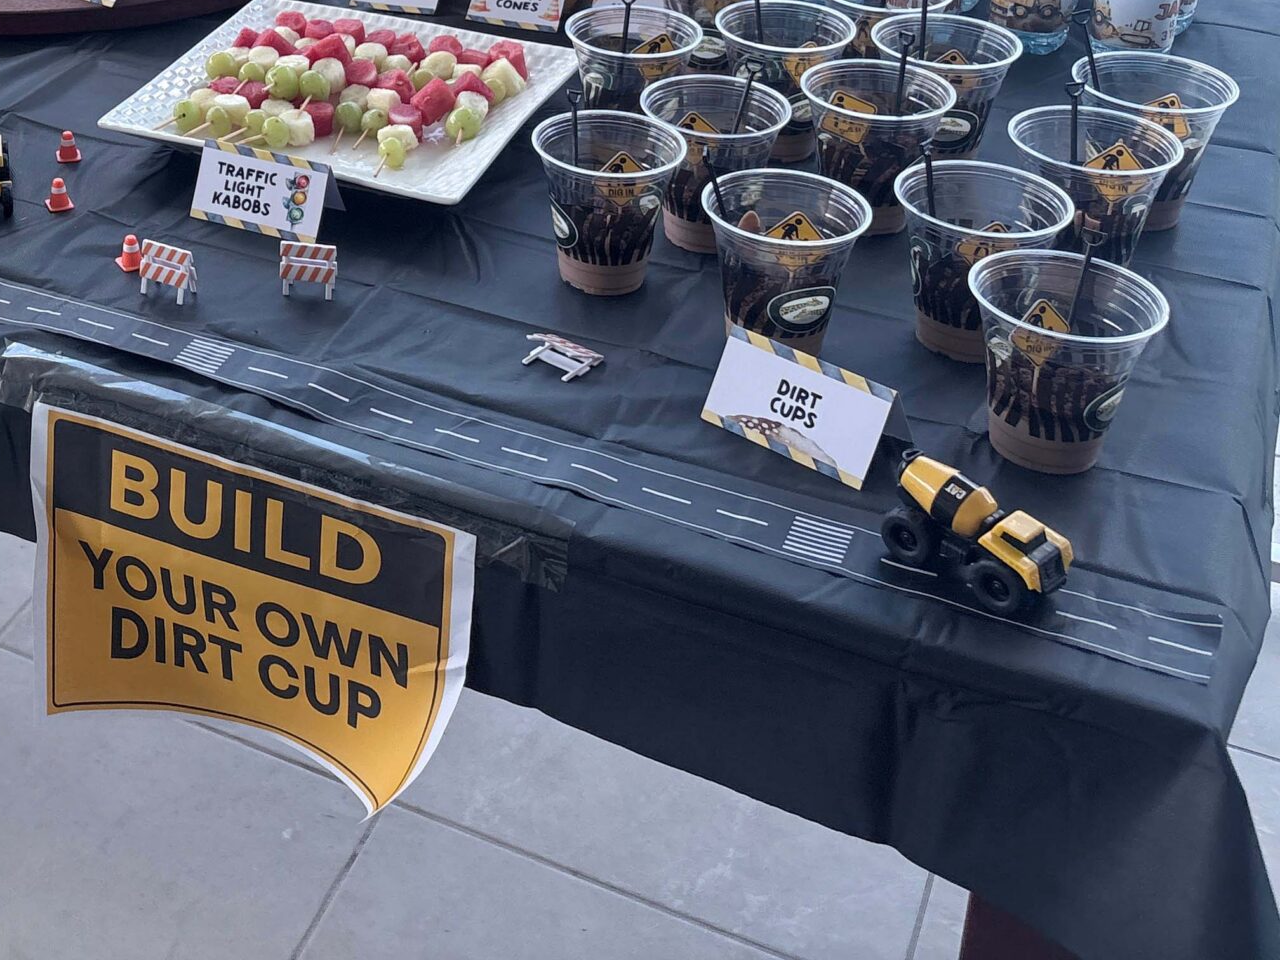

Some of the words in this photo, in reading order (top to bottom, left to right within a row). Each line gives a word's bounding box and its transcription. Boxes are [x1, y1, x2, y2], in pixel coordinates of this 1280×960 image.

[218, 161, 278, 186] TRAFFIC
[211, 191, 271, 216] KABOBS
[224, 180, 265, 199] LIGHT
[777, 379, 823, 409] DIRT
[770, 397, 818, 429] CUPS
[108, 448, 382, 585] BUILD
[77, 540, 239, 632] YOUR
[255, 601, 410, 689] OWN
[109, 605, 243, 682] DIRT
[257, 654, 382, 729] CUP
